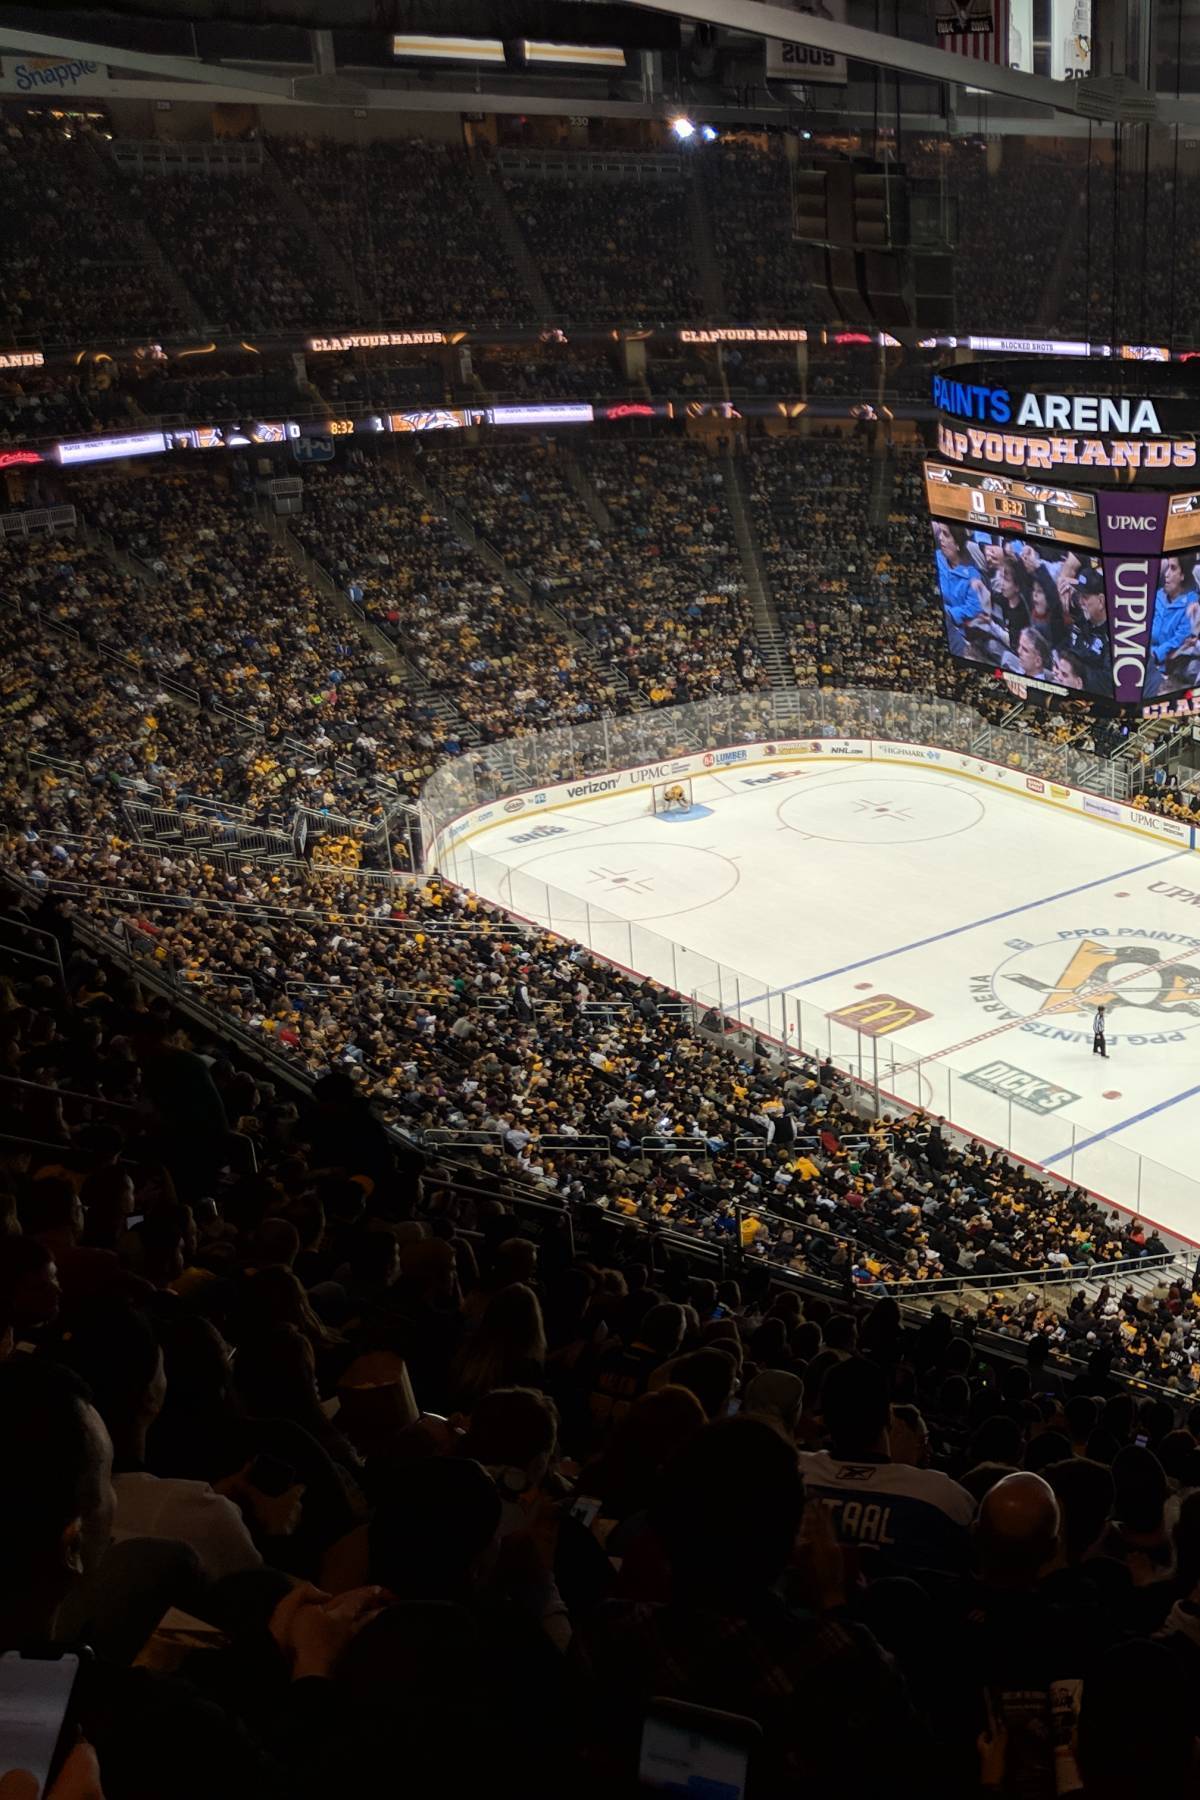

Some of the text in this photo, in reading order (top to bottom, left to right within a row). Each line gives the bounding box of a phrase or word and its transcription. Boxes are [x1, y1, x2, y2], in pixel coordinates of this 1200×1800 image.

[15, 60, 97, 91] Snapple
[390, 332, 442, 345] HANDS
[757, 329, 807, 341] HANDS
[1001, 341, 1030, 350] BLOCKED
[1032, 342, 1054, 351] SHOTS
[933, 375, 1162, 433] PAINTS ARENA
[331, 421, 354, 434] 8:32
[967, 428, 1053, 469] YOUR
[1051, 437, 1197, 468] HANDS
[971, 490, 986, 514] 0
[1002, 501, 1024, 517] 8:32
[1035, 503, 1050, 527] 1
[1107, 515, 1157, 532] UPMC
[1113, 561, 1149, 688] UPMC
[715, 750, 747, 763] LUMBER
[630, 765, 669, 783] UPMC
[567, 779, 616, 798] verizon
[1131, 811, 1160, 830] UPMC
[1057, 928, 1109, 941] PPG
[969, 974, 1021, 1021] ARENA
[1126, 1030, 1187, 1046] PPG
